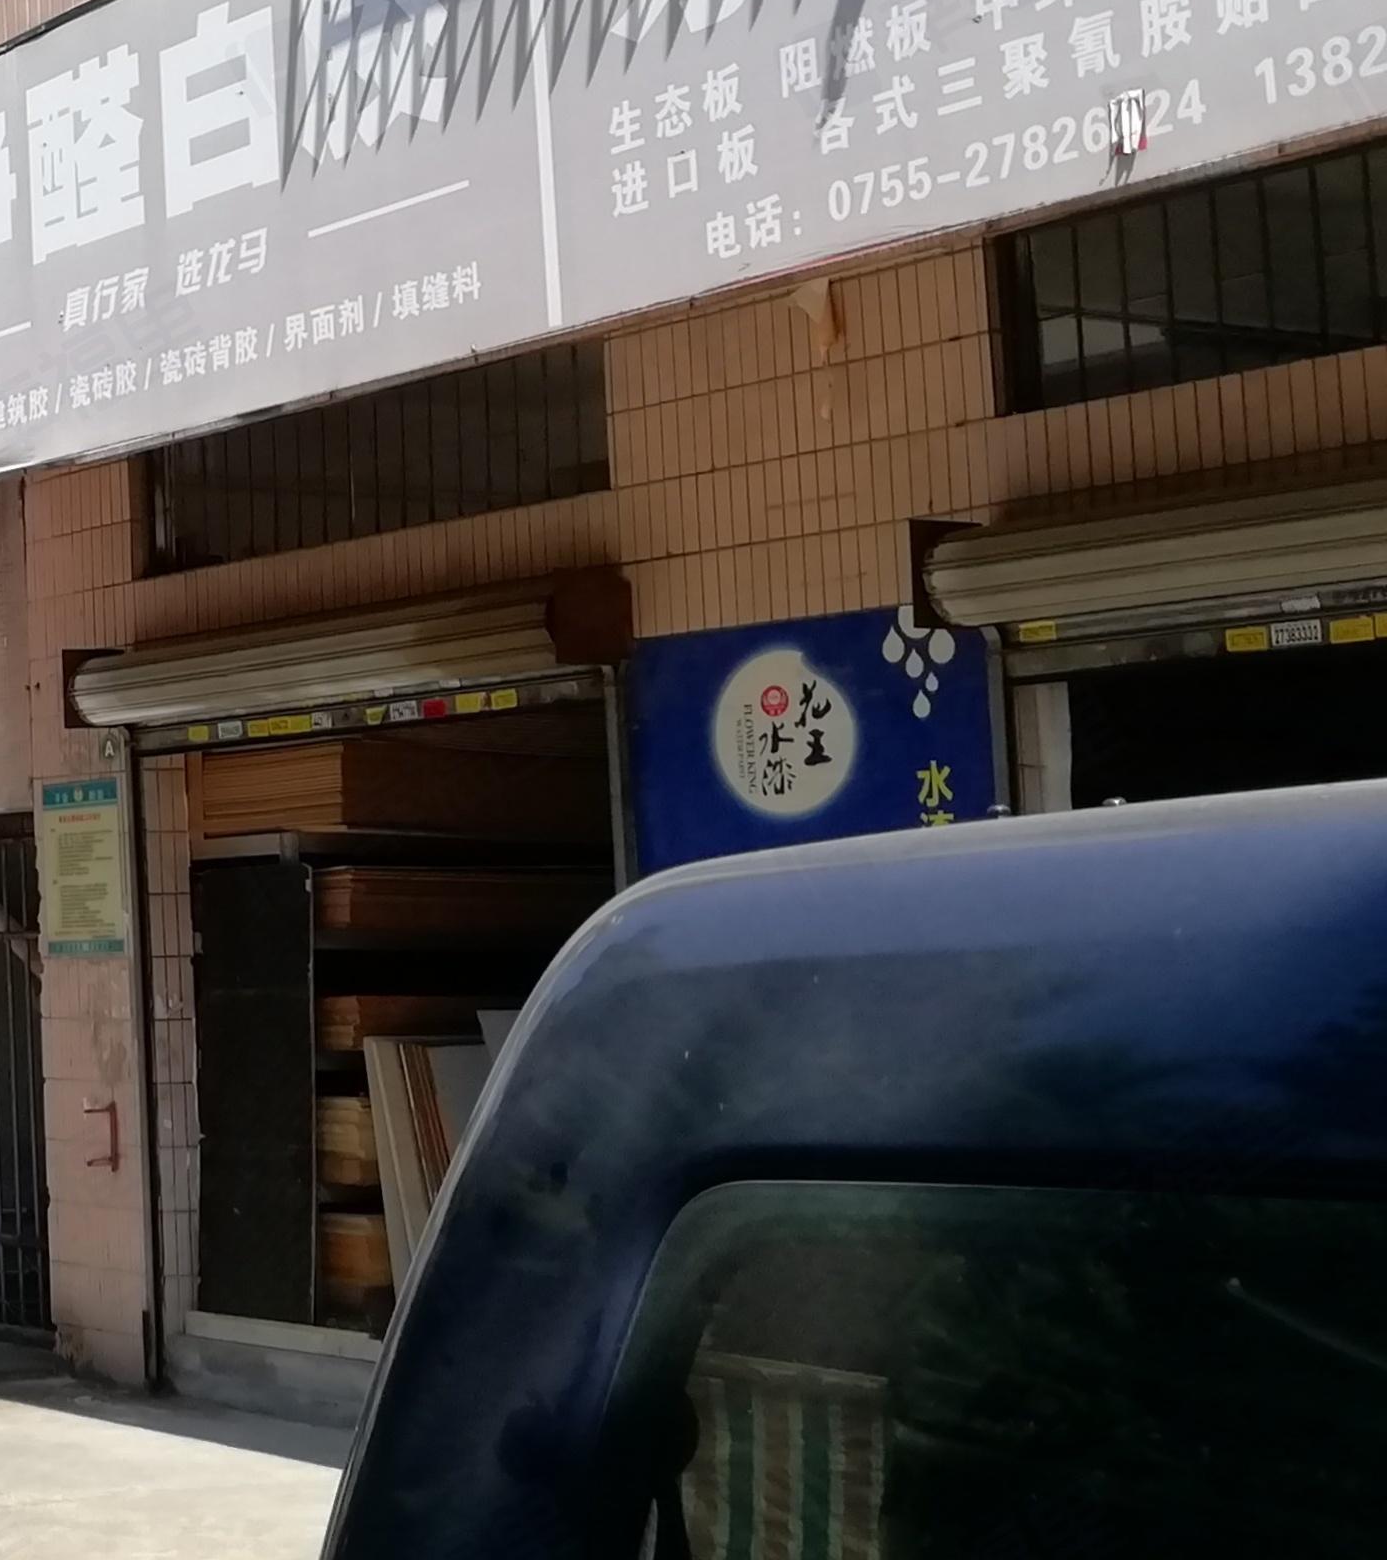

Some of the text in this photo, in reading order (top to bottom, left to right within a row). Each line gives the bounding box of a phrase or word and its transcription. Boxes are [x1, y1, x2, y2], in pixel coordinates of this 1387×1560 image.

[608, 63, 743, 156] 生态板
[827, 78, 1208, 223] 0755-2782624
[610, 123, 759, 219] 进口板
[62, 227, 269, 334] 真行家 选龙马
